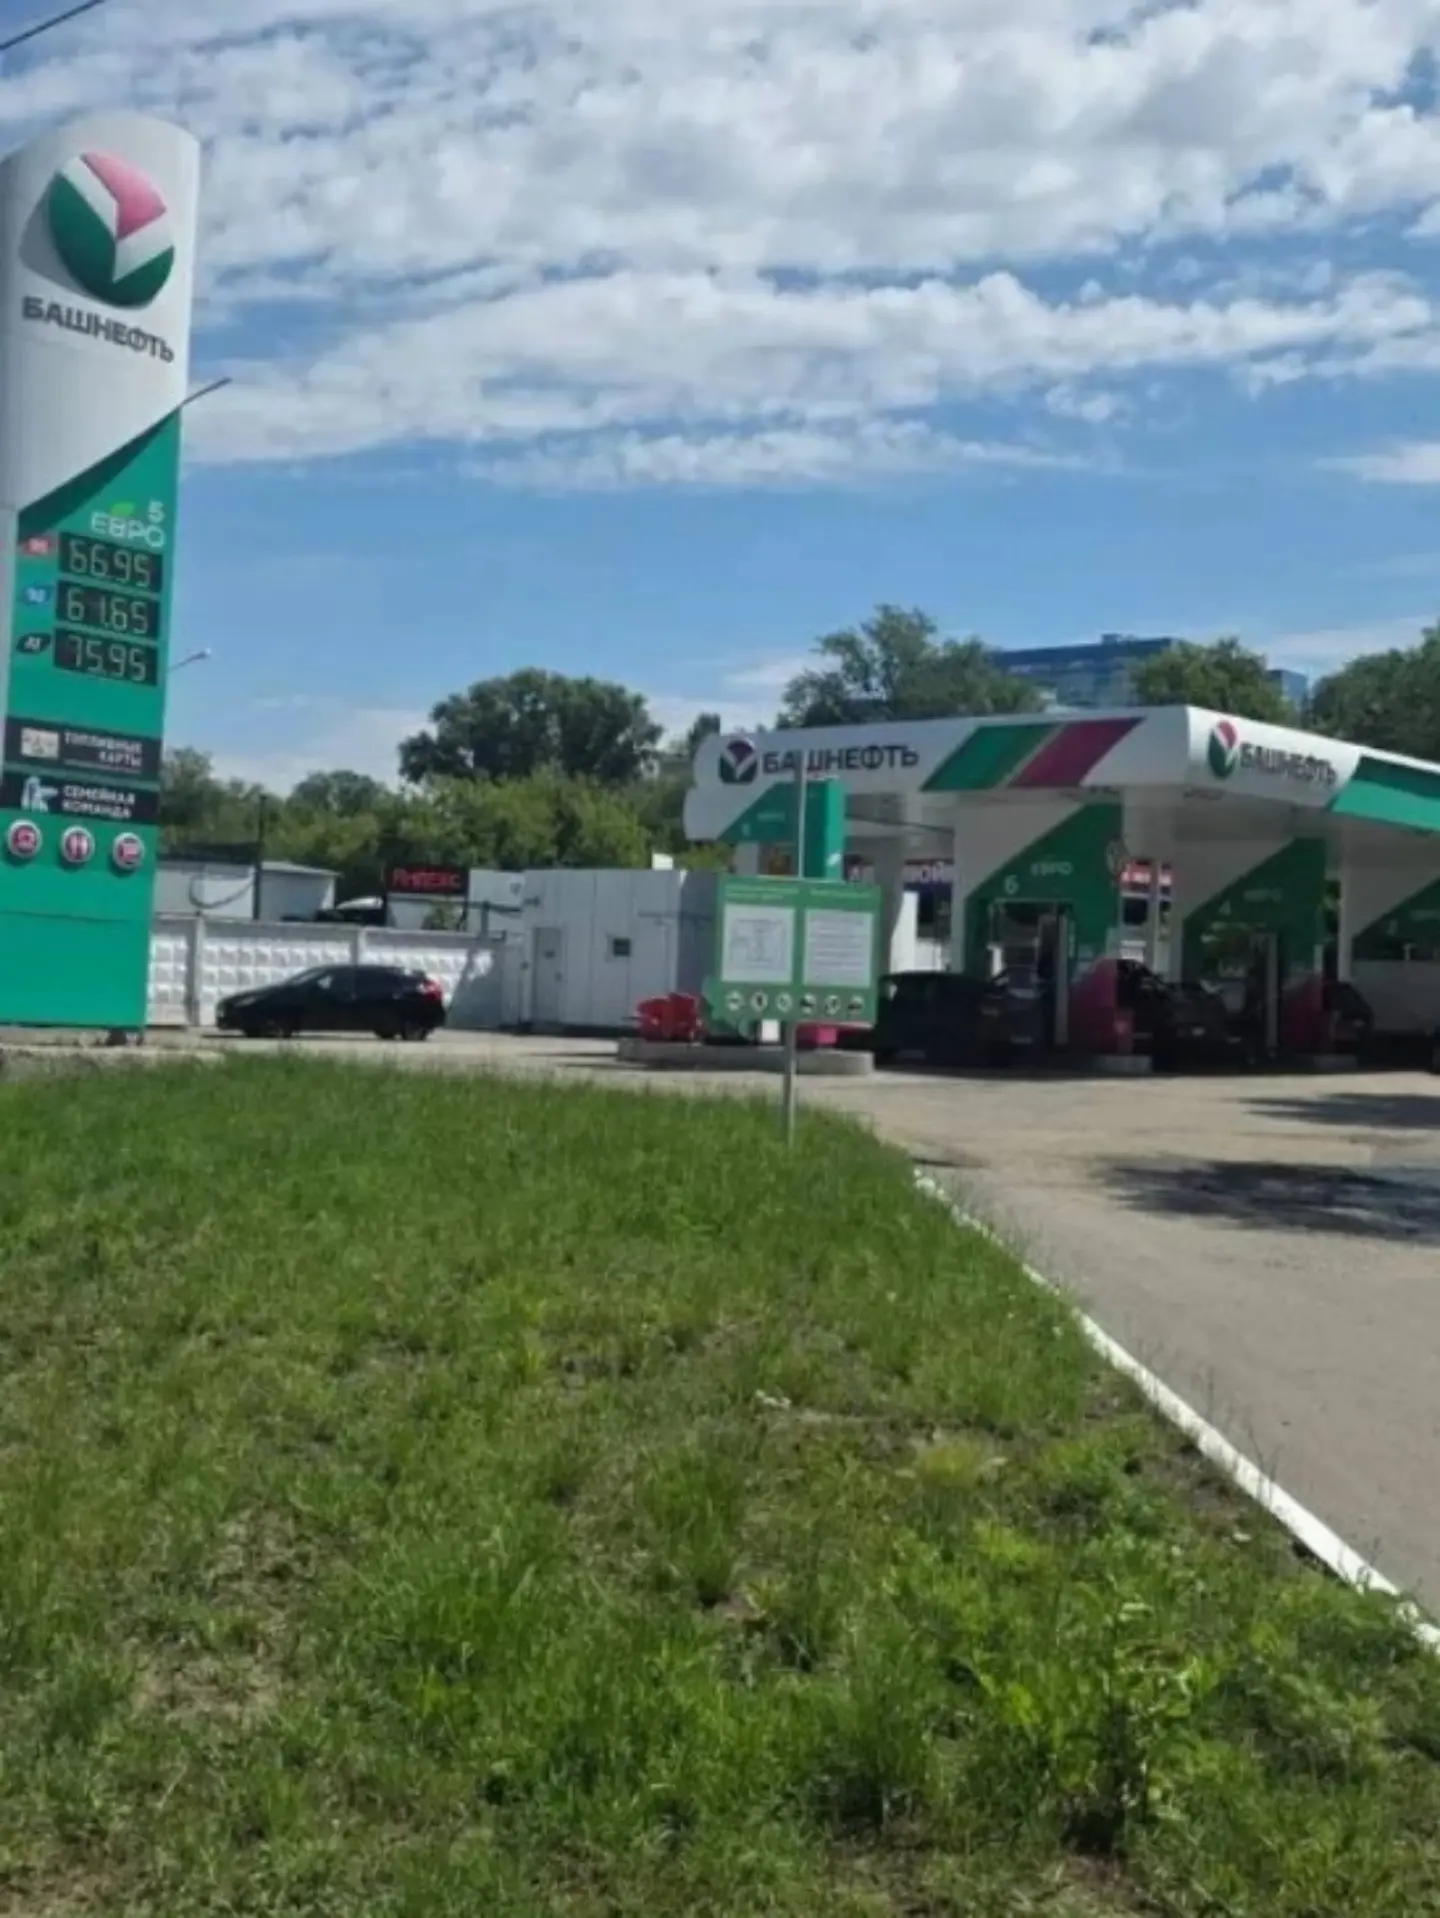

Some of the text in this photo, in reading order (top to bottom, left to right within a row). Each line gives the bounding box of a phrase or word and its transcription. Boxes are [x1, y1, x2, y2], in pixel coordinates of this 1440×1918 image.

[22, 295, 175, 364] БАШНЕФТЬ
[91, 501, 165, 548] ЕВРО 5
[763, 746, 920, 775] БАШНЕФТЬ
[1240, 742, 1338, 785] БАШНЕФТЬ
